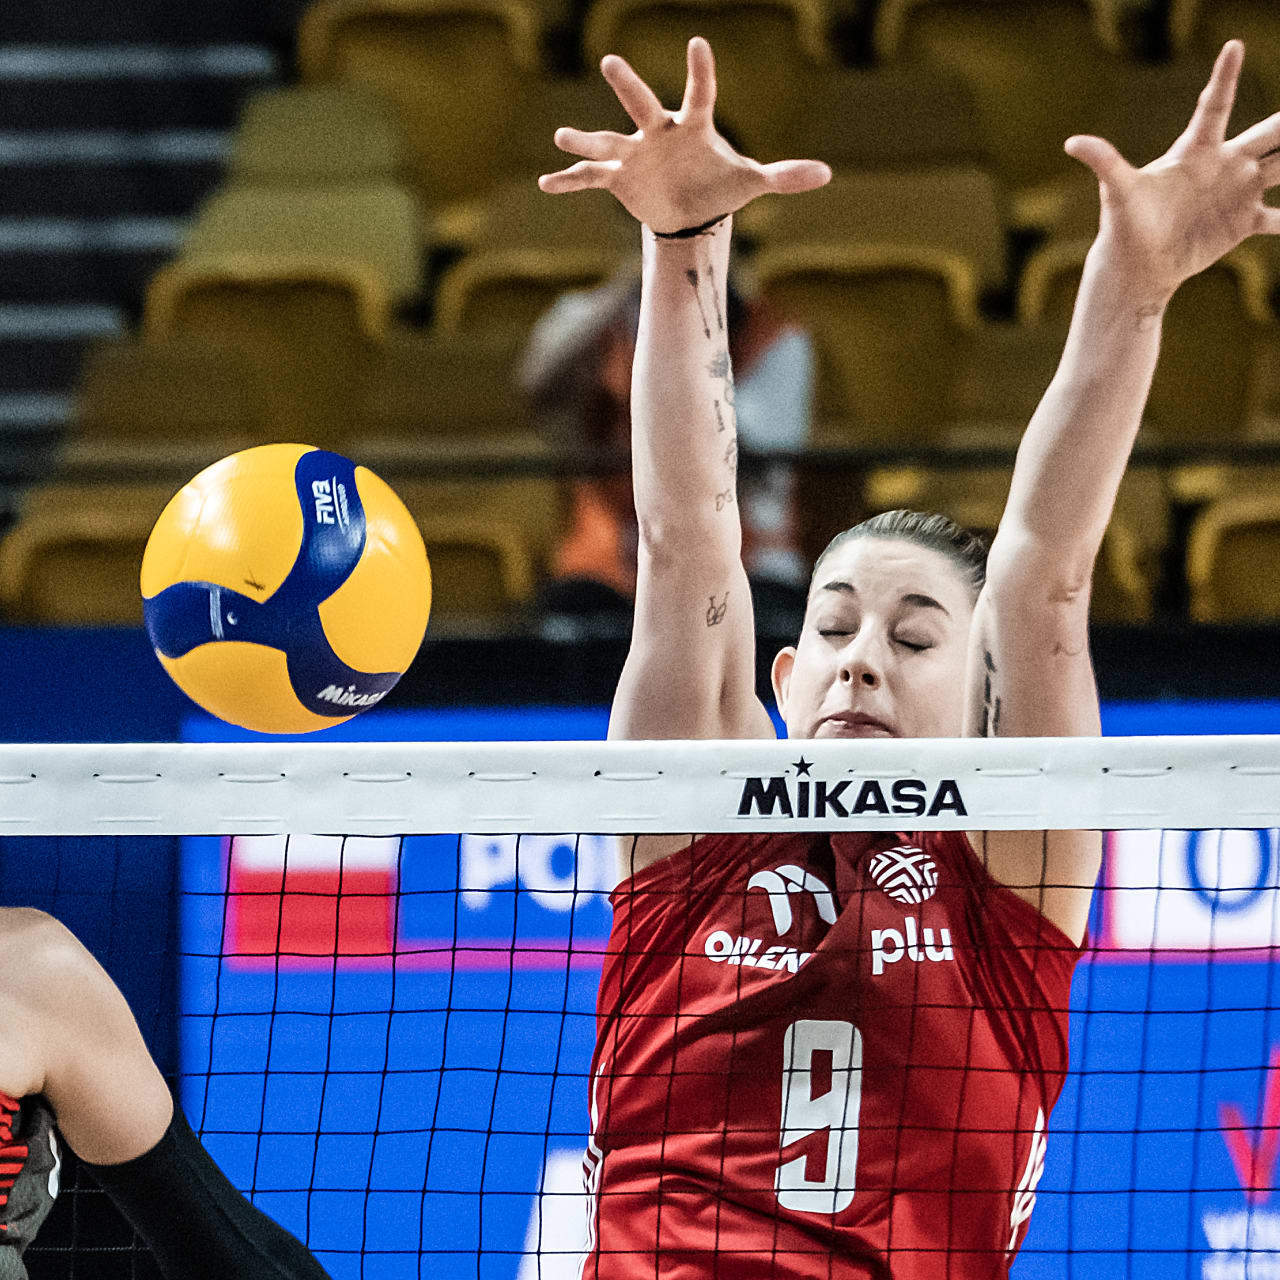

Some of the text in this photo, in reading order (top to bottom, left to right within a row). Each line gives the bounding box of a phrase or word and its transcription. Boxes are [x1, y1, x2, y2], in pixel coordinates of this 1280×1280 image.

[312, 479, 335, 524] FIVB
[738, 756, 968, 818] MIKASA
[774, 1019, 863, 1214] 9
